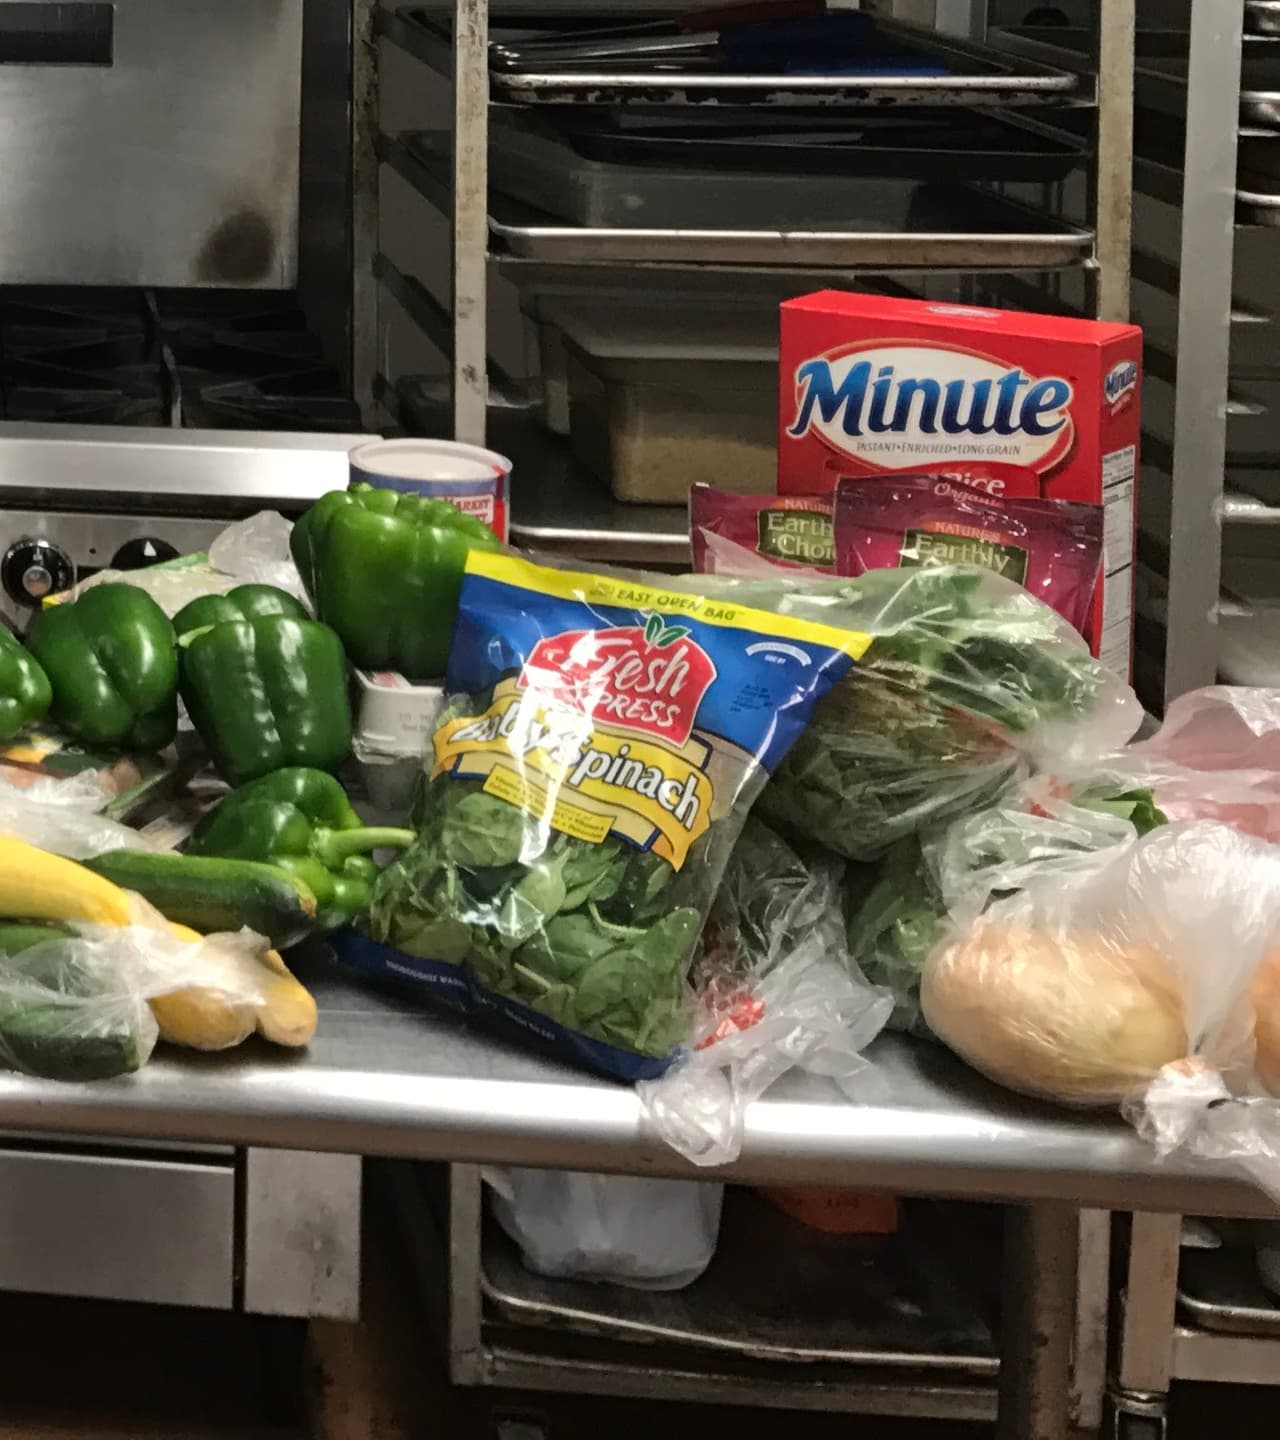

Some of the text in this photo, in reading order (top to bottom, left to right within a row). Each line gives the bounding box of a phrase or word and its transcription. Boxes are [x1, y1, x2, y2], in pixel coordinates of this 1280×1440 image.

[787, 359, 1072, 437] Minute
[856, 441, 1022, 456] INSTANT ENRICHED LONG GRAIN
[767, 511, 833, 537] Earth
[777, 533, 833, 560] Choi
[915, 533, 1010, 574] Earthly
[656, 594, 704, 613] OPEN
[704, 607, 736, 622] BAG
